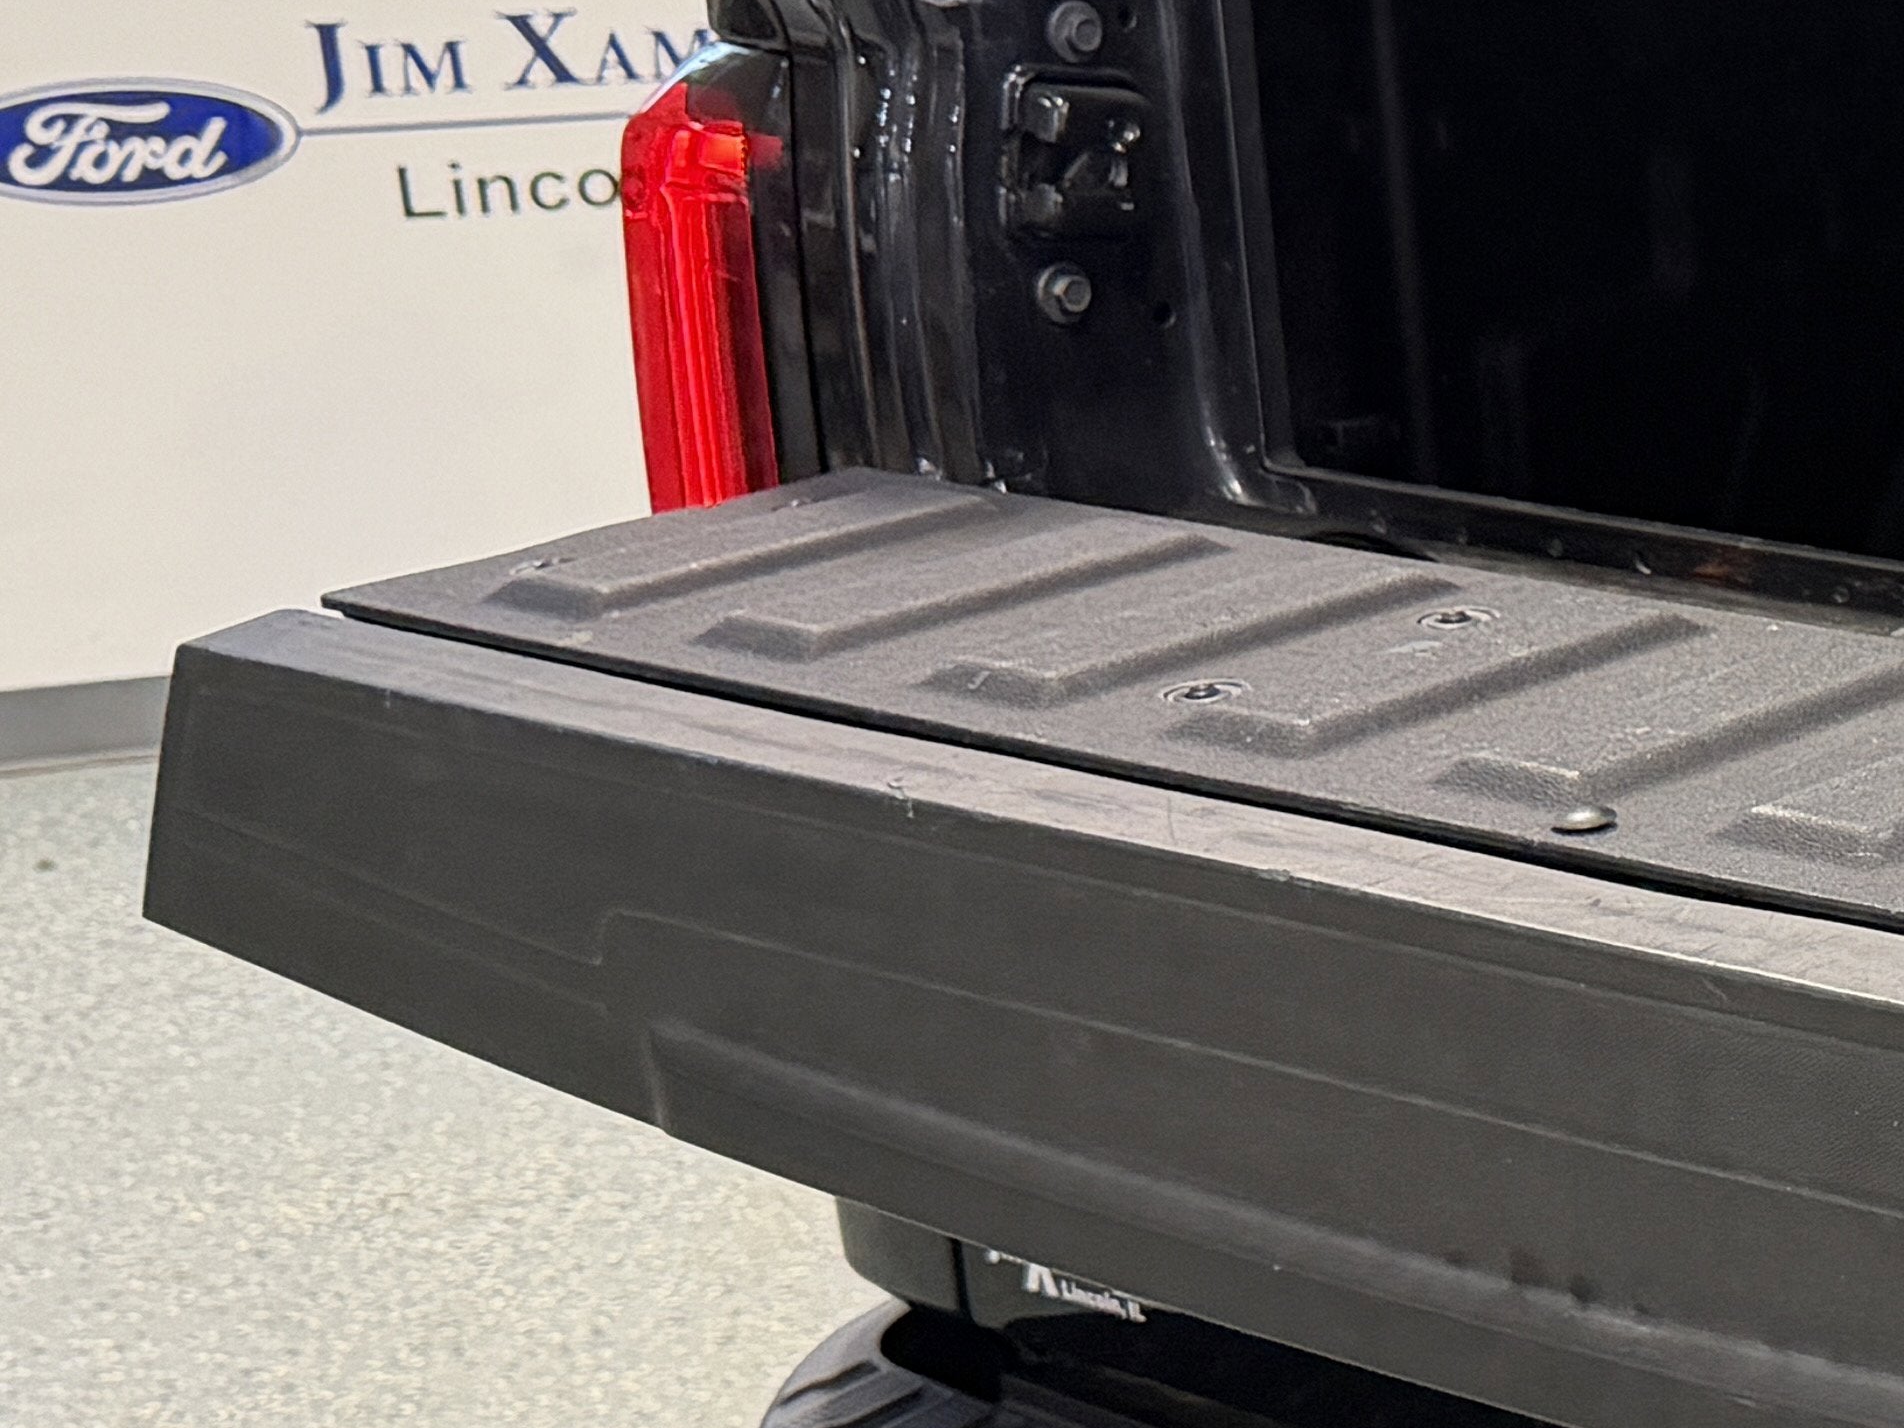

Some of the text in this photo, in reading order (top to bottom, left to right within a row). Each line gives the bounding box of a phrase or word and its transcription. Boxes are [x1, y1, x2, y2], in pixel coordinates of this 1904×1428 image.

[304, 6, 709, 115] JIM XAM
[8, 101, 230, 185] Ford
[398, 162, 621, 220] Linco
